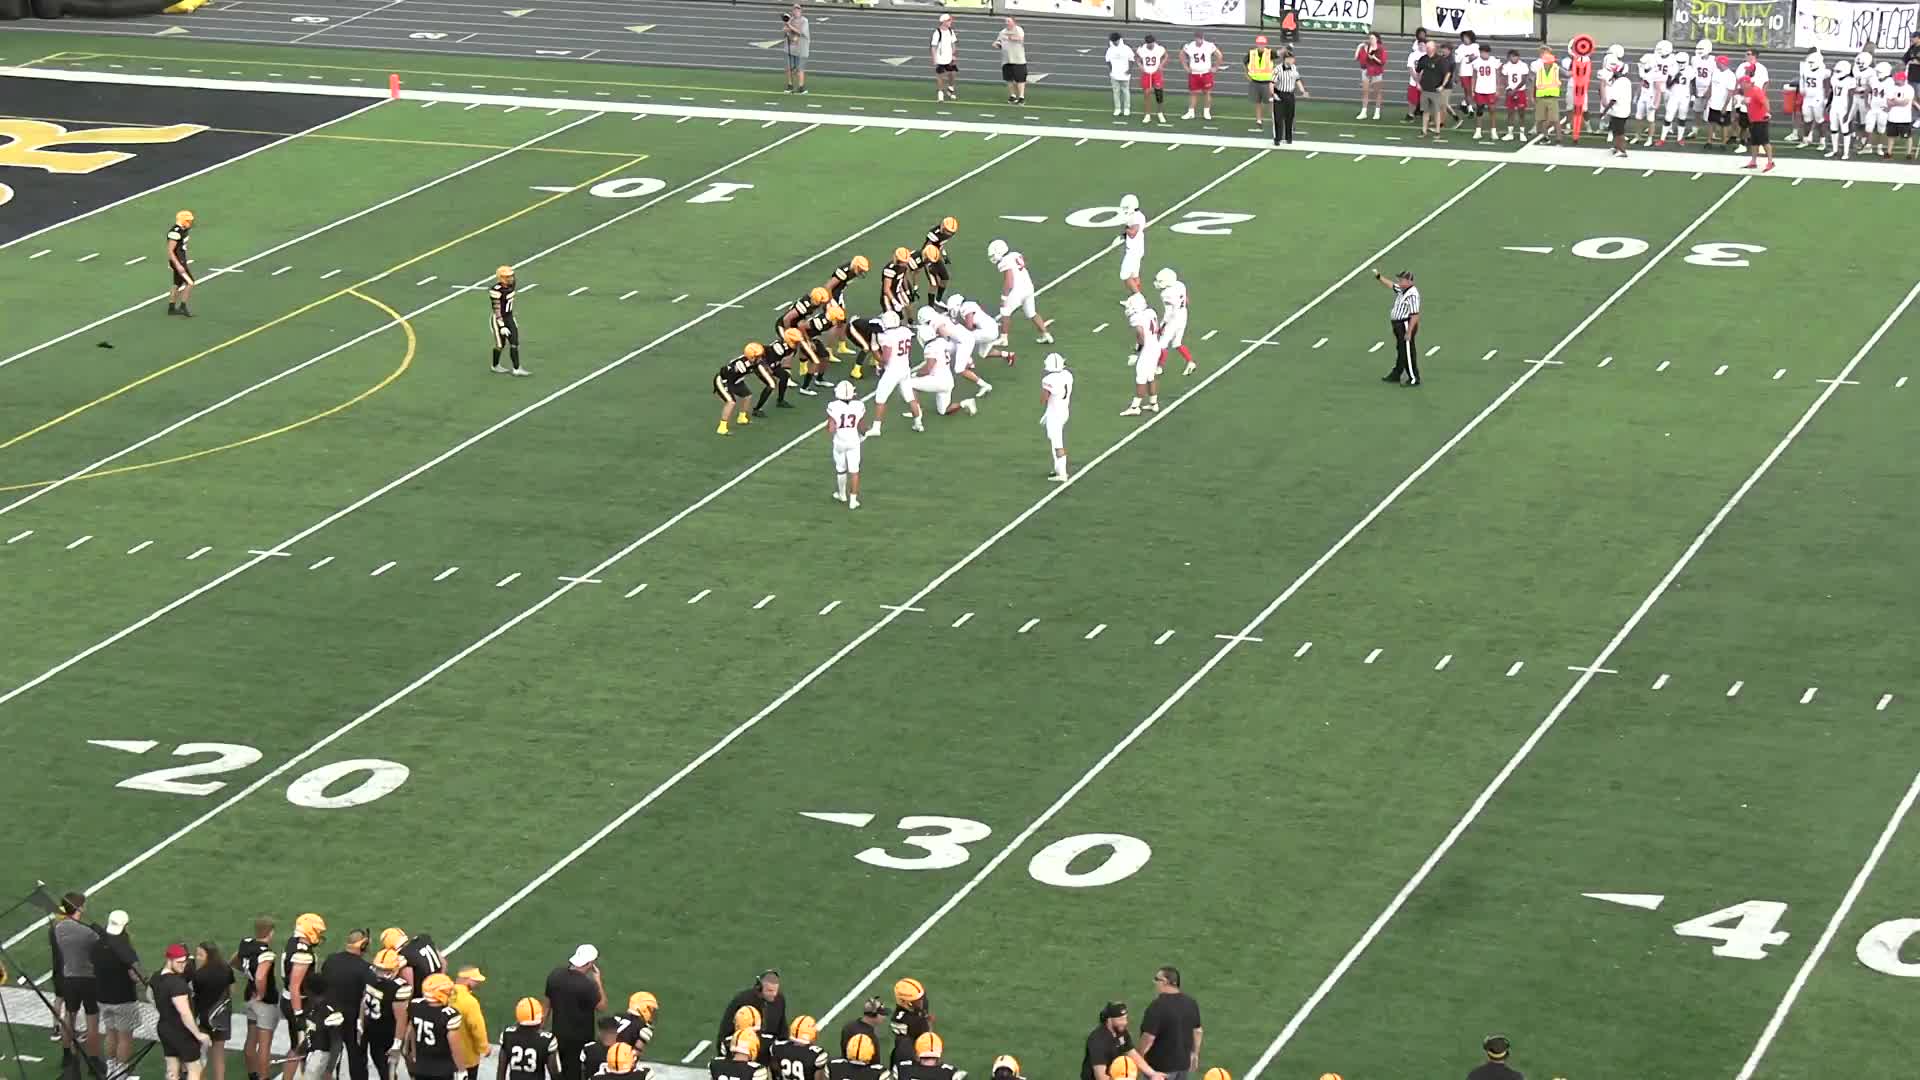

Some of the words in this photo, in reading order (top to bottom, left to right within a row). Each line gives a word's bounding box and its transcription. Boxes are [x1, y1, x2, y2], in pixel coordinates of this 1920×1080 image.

[1282, 11, 1298, 31] 4
[1768, 14, 1784, 30] 10
[1145, 56, 1157, 66] 29
[1193, 53, 1206, 63] 54
[1511, 73, 1518, 83] 6
[587, 177, 755, 203] 10
[1065, 206, 1257, 235] 20
[1571, 236, 1768, 267] 30
[838, 413, 856, 429] 13
[115, 742, 410, 809] 20
[854, 815, 1152, 888] 30
[418, 944, 442, 973] 71
[413, 1016, 437, 1047] 75
[510, 1045, 538, 1073] 23
[780, 1058, 805, 1080] 29
